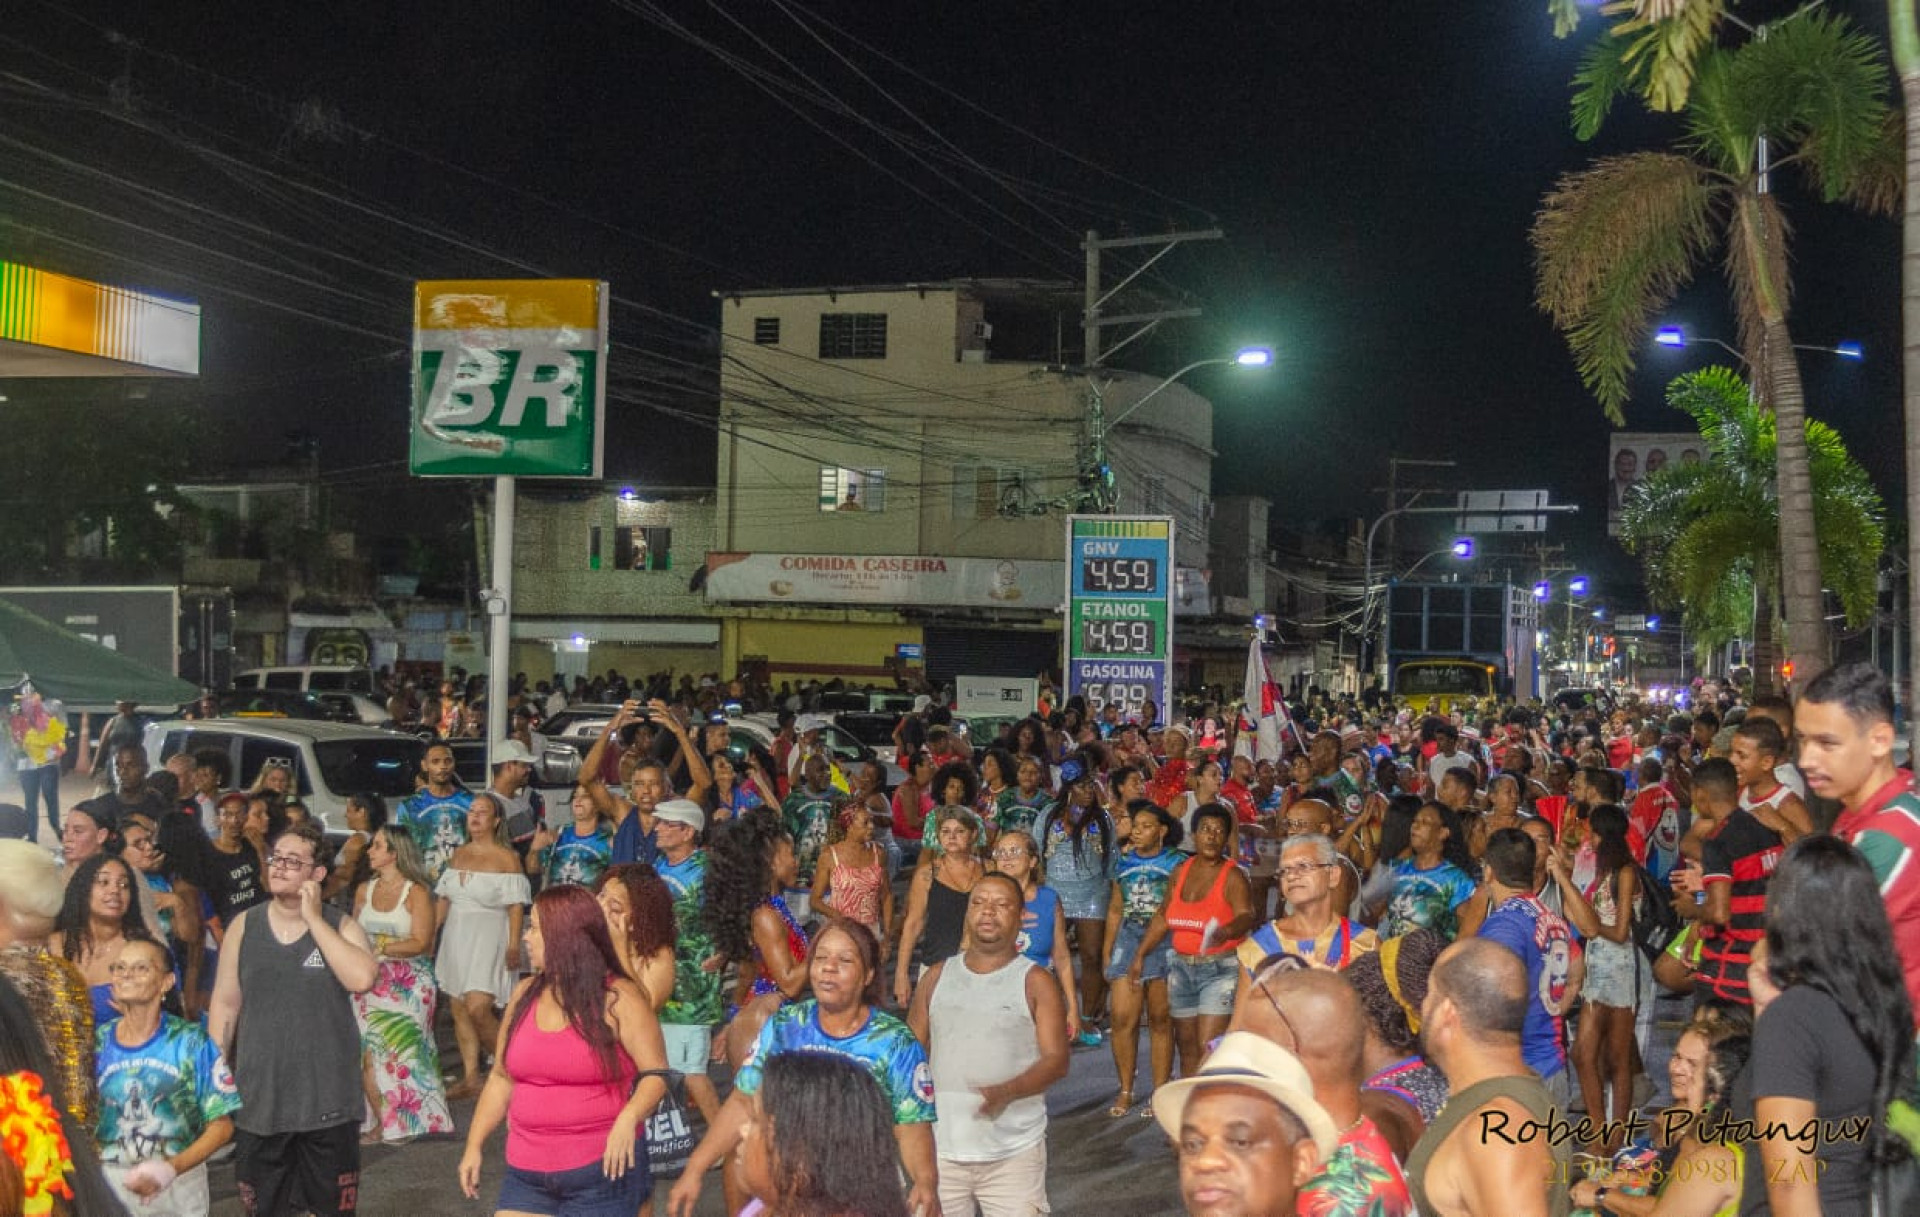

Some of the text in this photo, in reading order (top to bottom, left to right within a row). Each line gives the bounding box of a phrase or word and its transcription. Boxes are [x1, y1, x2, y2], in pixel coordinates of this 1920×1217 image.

[425, 349, 579, 428] BR
[1083, 541, 1119, 555] GNV
[780, 556, 947, 573] COMIDA CASEIRA
[1081, 603, 1150, 617] ETANOL
[1081, 664, 1155, 679] GASOLINA
